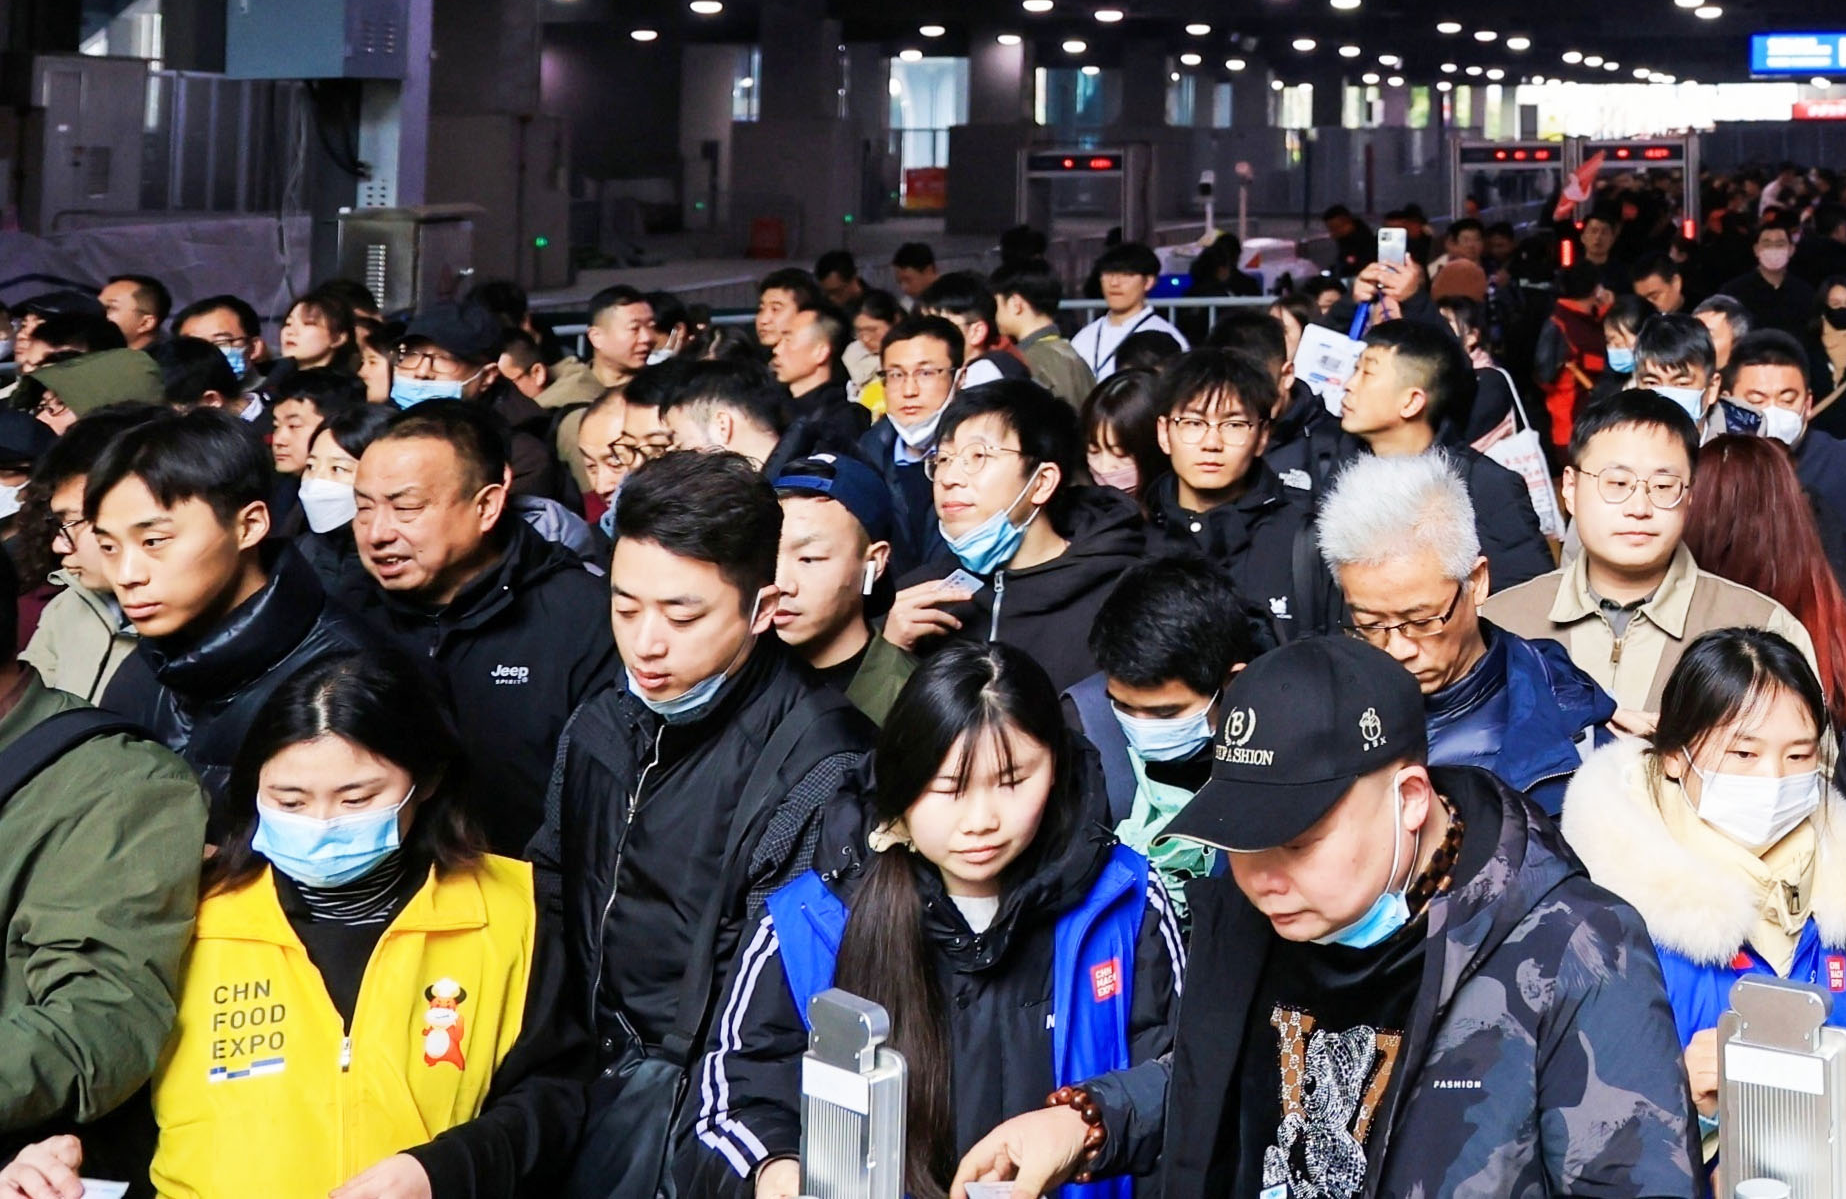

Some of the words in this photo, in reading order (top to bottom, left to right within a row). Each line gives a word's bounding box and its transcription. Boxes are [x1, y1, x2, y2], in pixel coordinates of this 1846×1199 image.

[490, 664, 529, 680] Jeep
[213, 978, 271, 1004] CHN
[212, 1004, 286, 1032] FOOD
[212, 1031, 285, 1060] EXPO
[1433, 1080, 1482, 1089] FASHION
